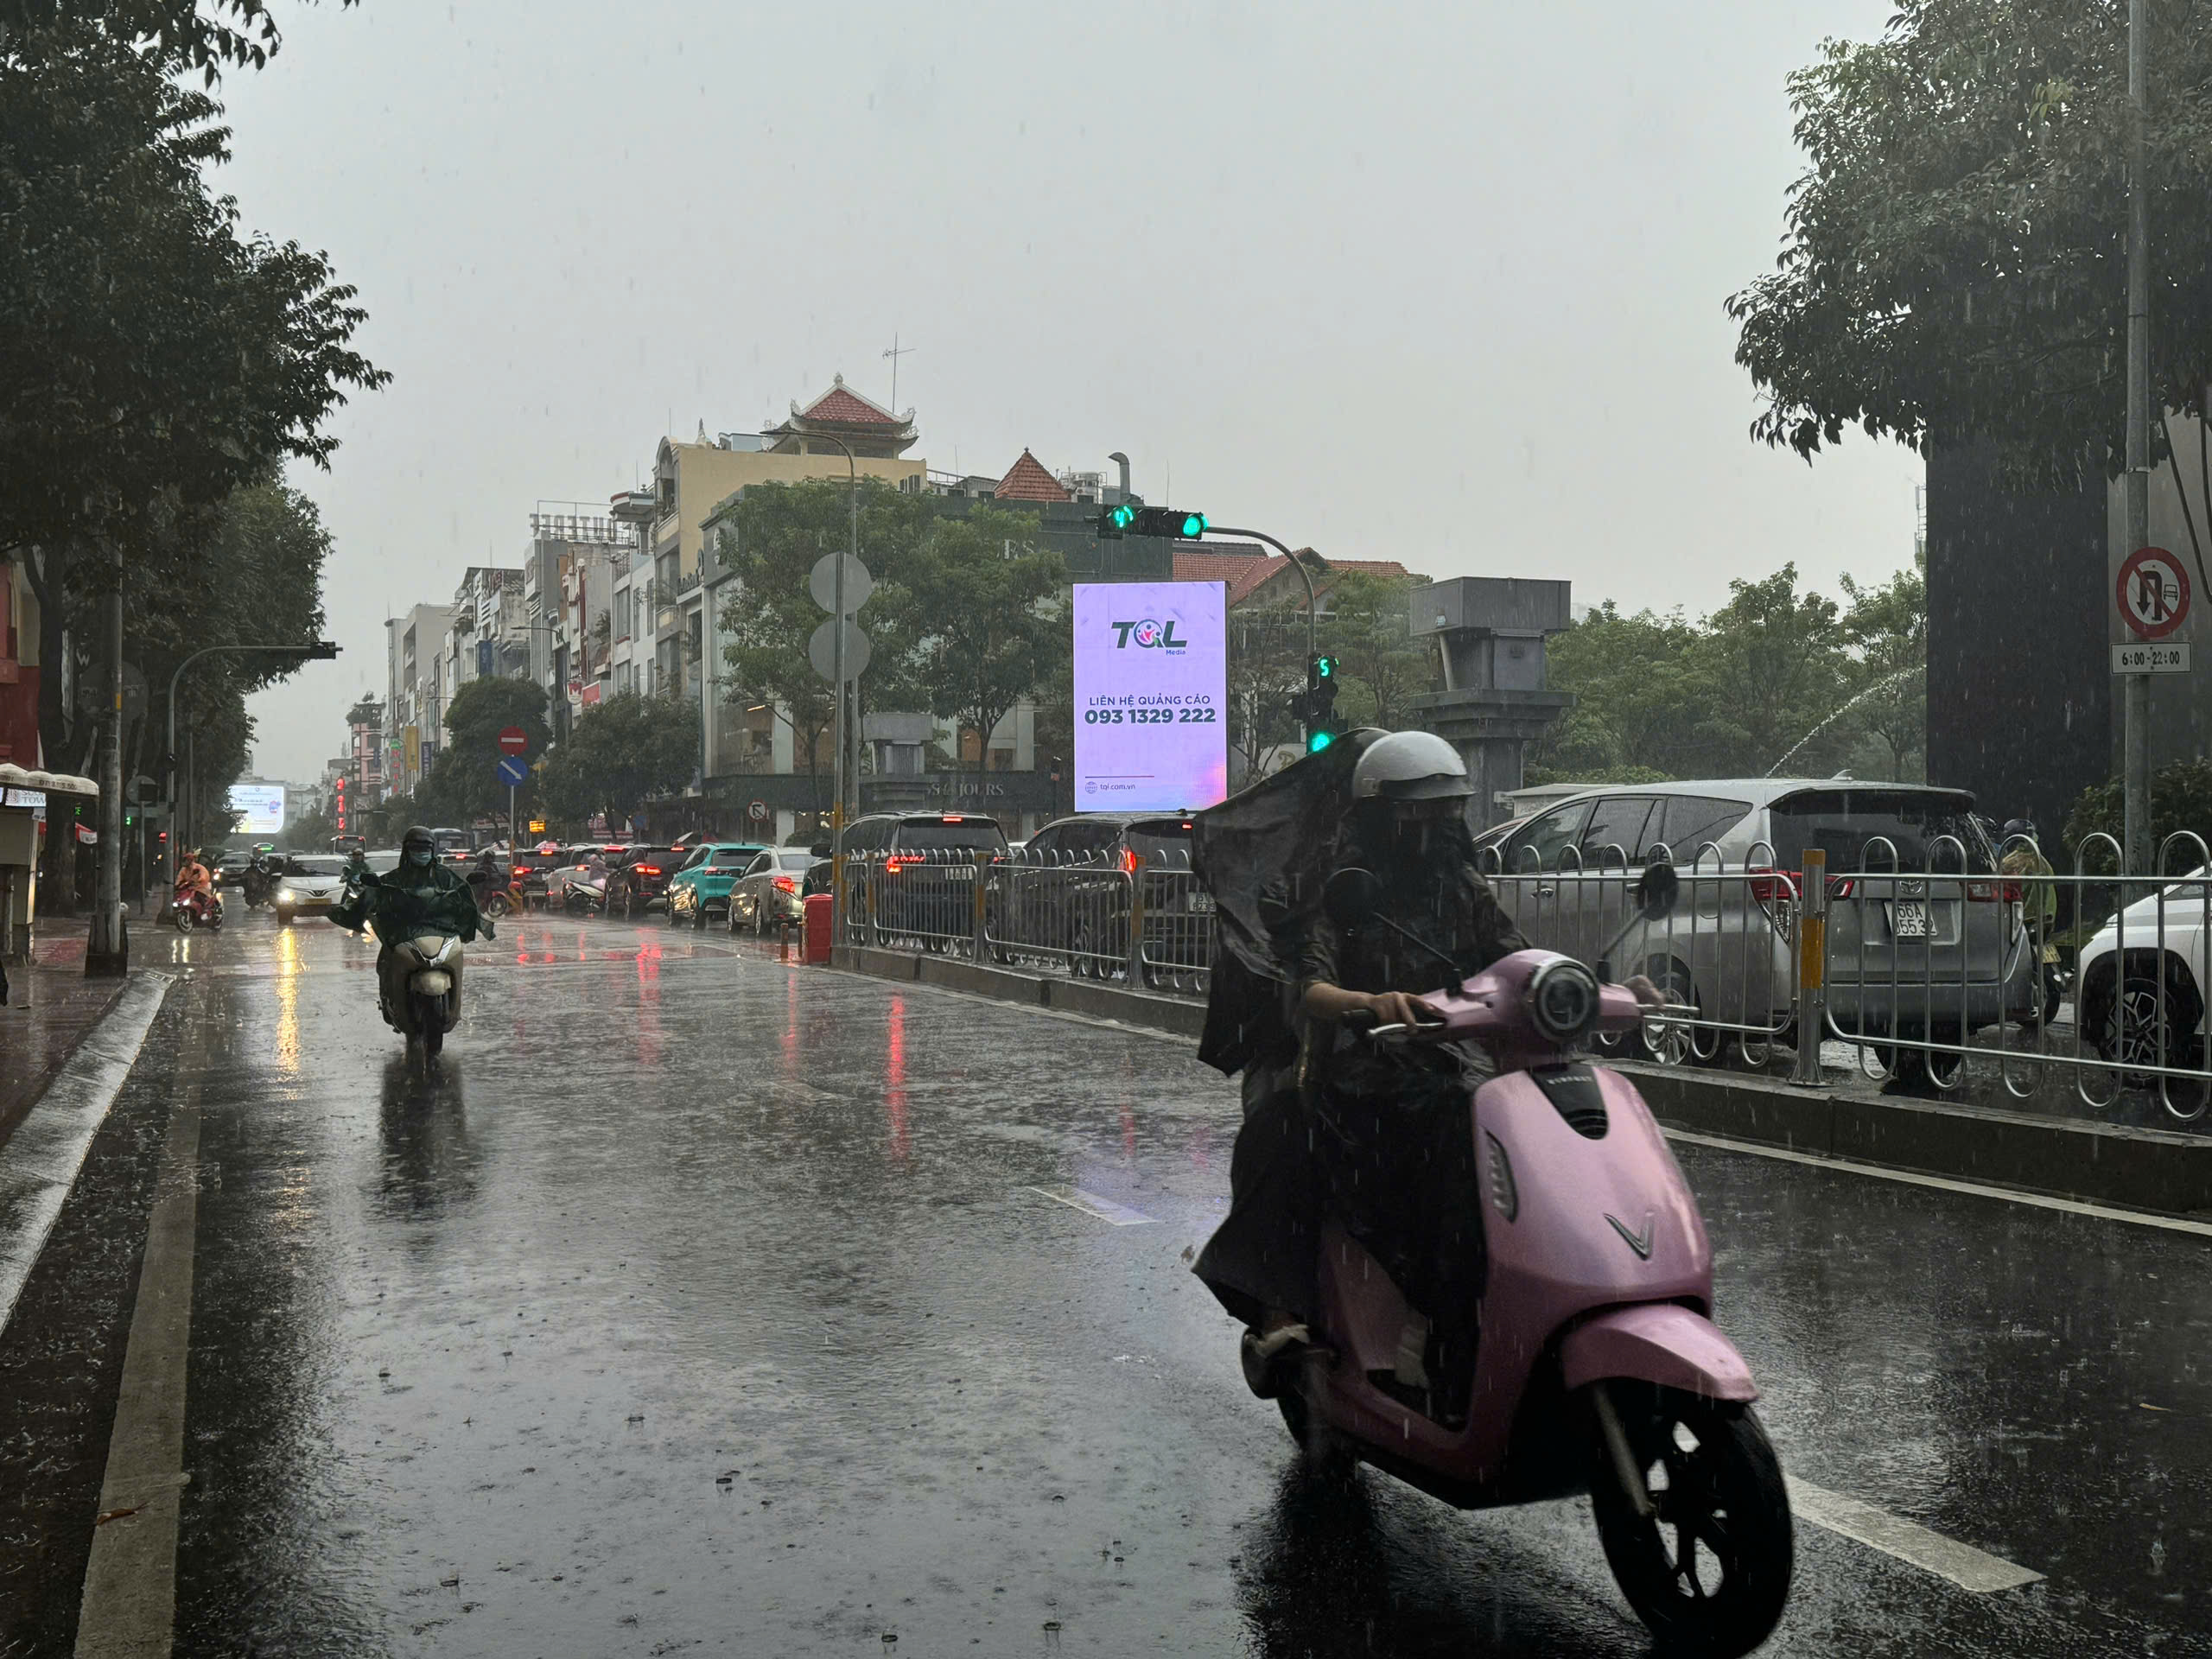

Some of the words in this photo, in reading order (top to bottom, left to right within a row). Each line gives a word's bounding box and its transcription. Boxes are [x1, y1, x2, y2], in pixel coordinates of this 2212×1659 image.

[1111, 619, 1187, 649] TQL
[1090, 695, 1115, 706] LIÊN
[1119, 695, 1135, 708] HỆ
[1138, 693, 1181, 705] QUẢNG
[1185, 694, 1211, 704] CÁO
[1084, 709, 1123, 724] 093
[1128, 709, 1173, 724] 1329
[1179, 708, 1217, 723] 222
[1897, 903, 1923, 918] 66A
